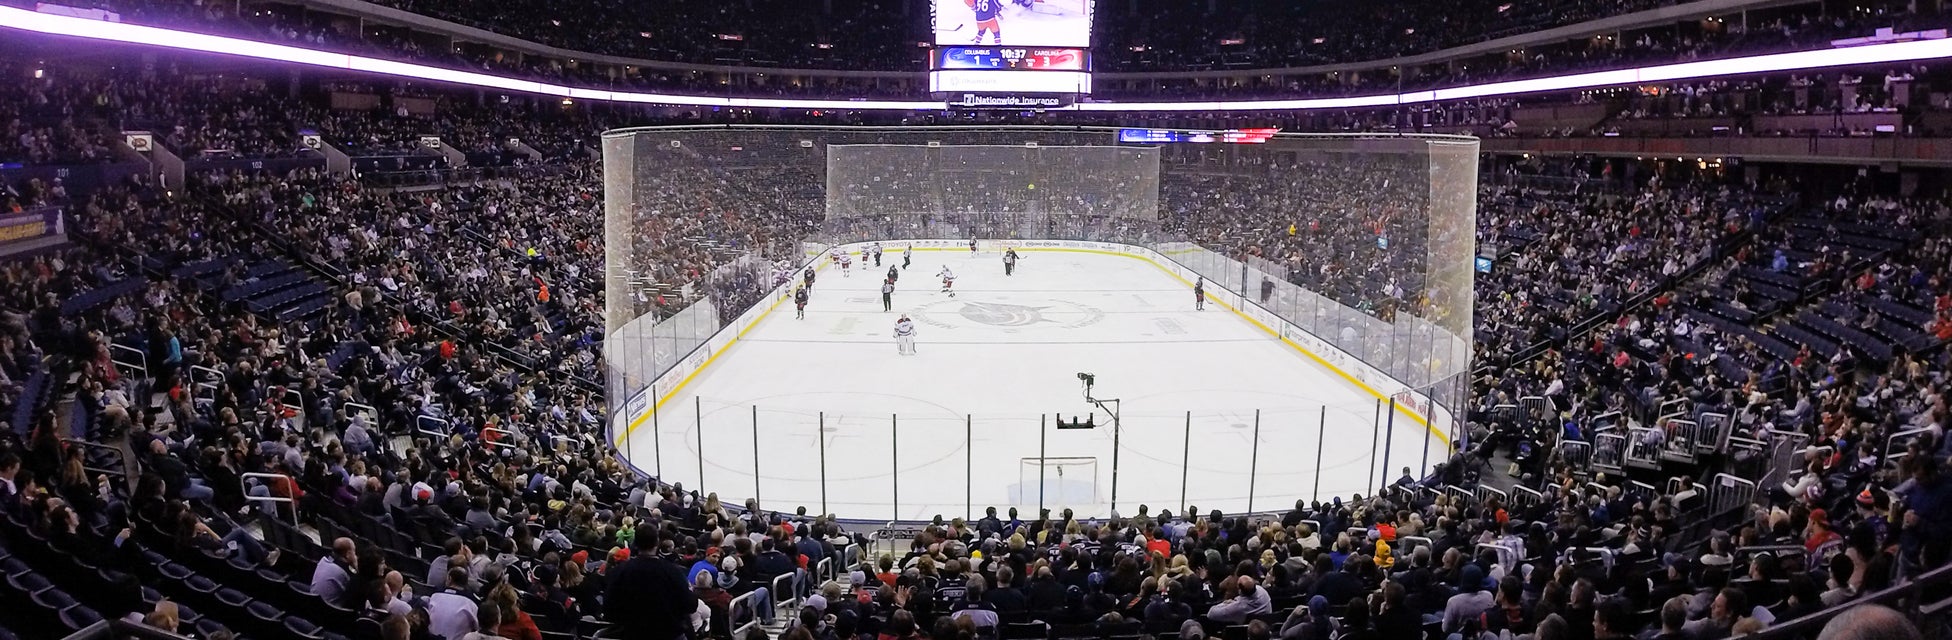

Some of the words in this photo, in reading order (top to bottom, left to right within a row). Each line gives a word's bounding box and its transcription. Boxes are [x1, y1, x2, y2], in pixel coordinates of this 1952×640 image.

[1000, 49, 1026, 59] 10:37
[973, 55, 980, 66] 1
[1043, 56, 1050, 67] 3
[975, 95, 1020, 105] Nationwide
[251, 161, 263, 169] 102
[57, 167, 69, 178] 101
